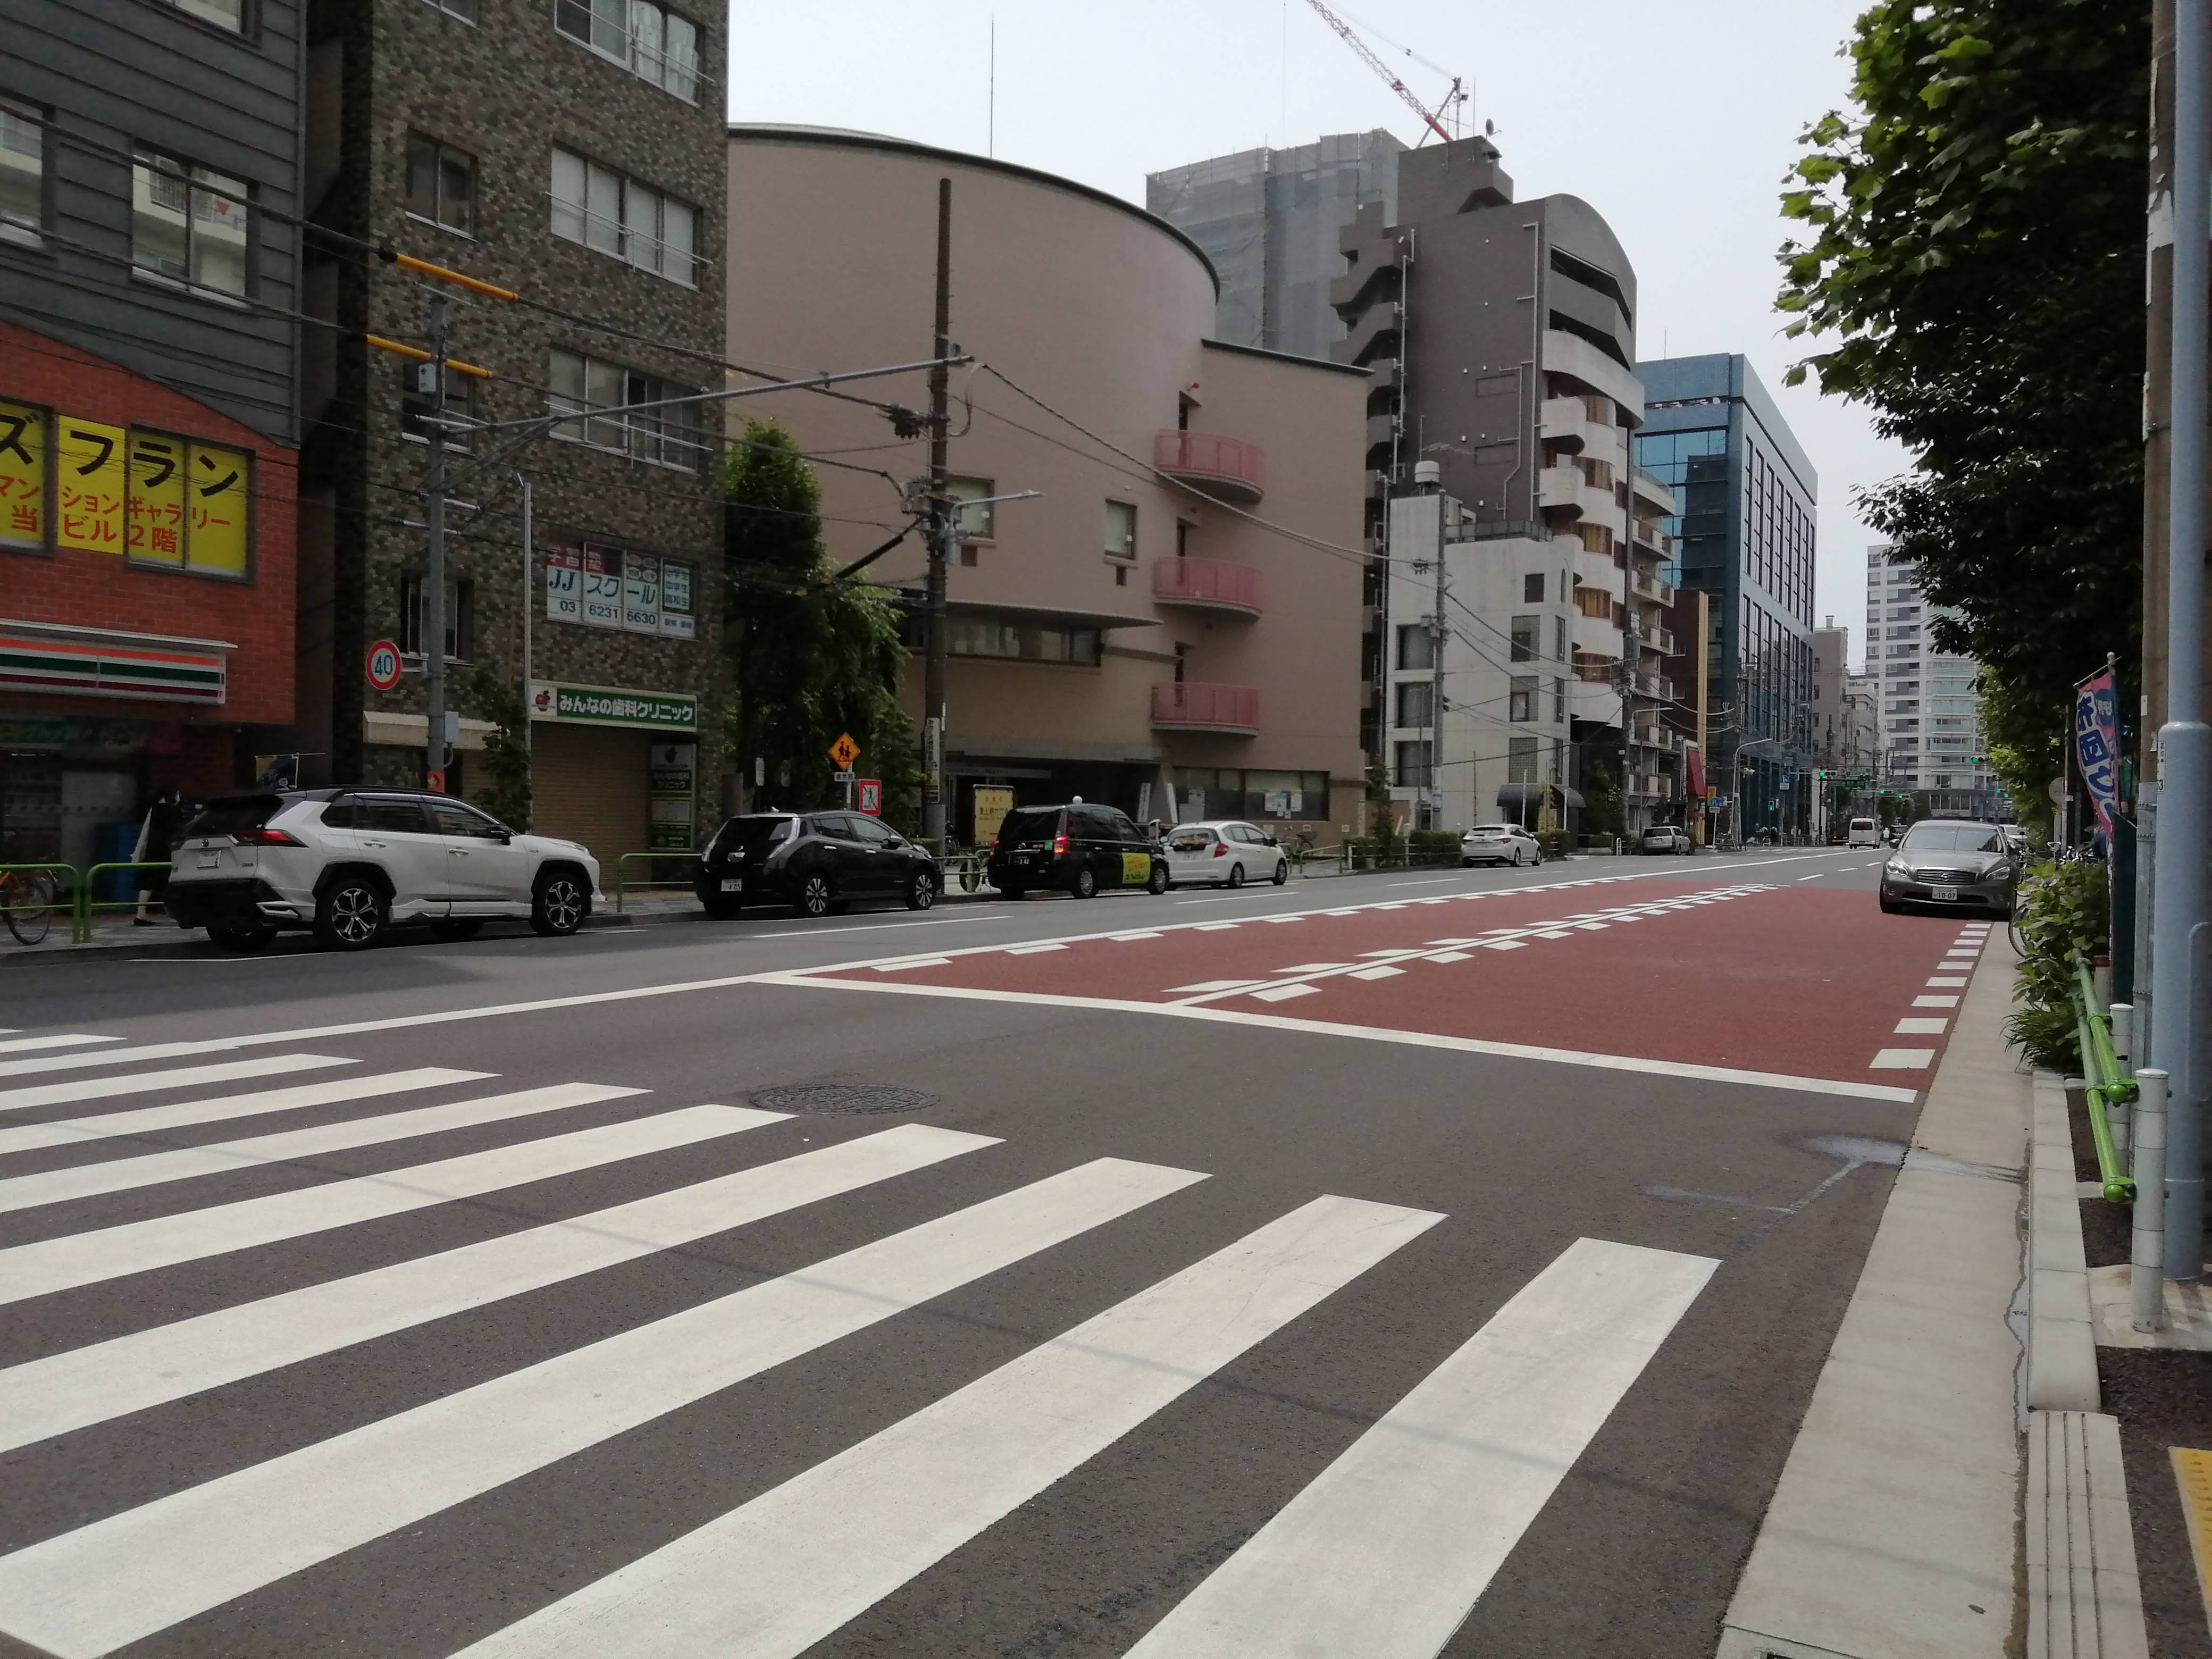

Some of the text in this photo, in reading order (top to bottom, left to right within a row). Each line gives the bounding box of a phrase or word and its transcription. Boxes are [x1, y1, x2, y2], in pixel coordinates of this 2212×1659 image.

[560, 601, 576, 613] 03
[590, 605, 618, 619] 6231
[627, 611, 656, 625] 6630
[374, 655, 393, 675] 40
[560, 695, 693, 722] みんなの歯科クリニック
